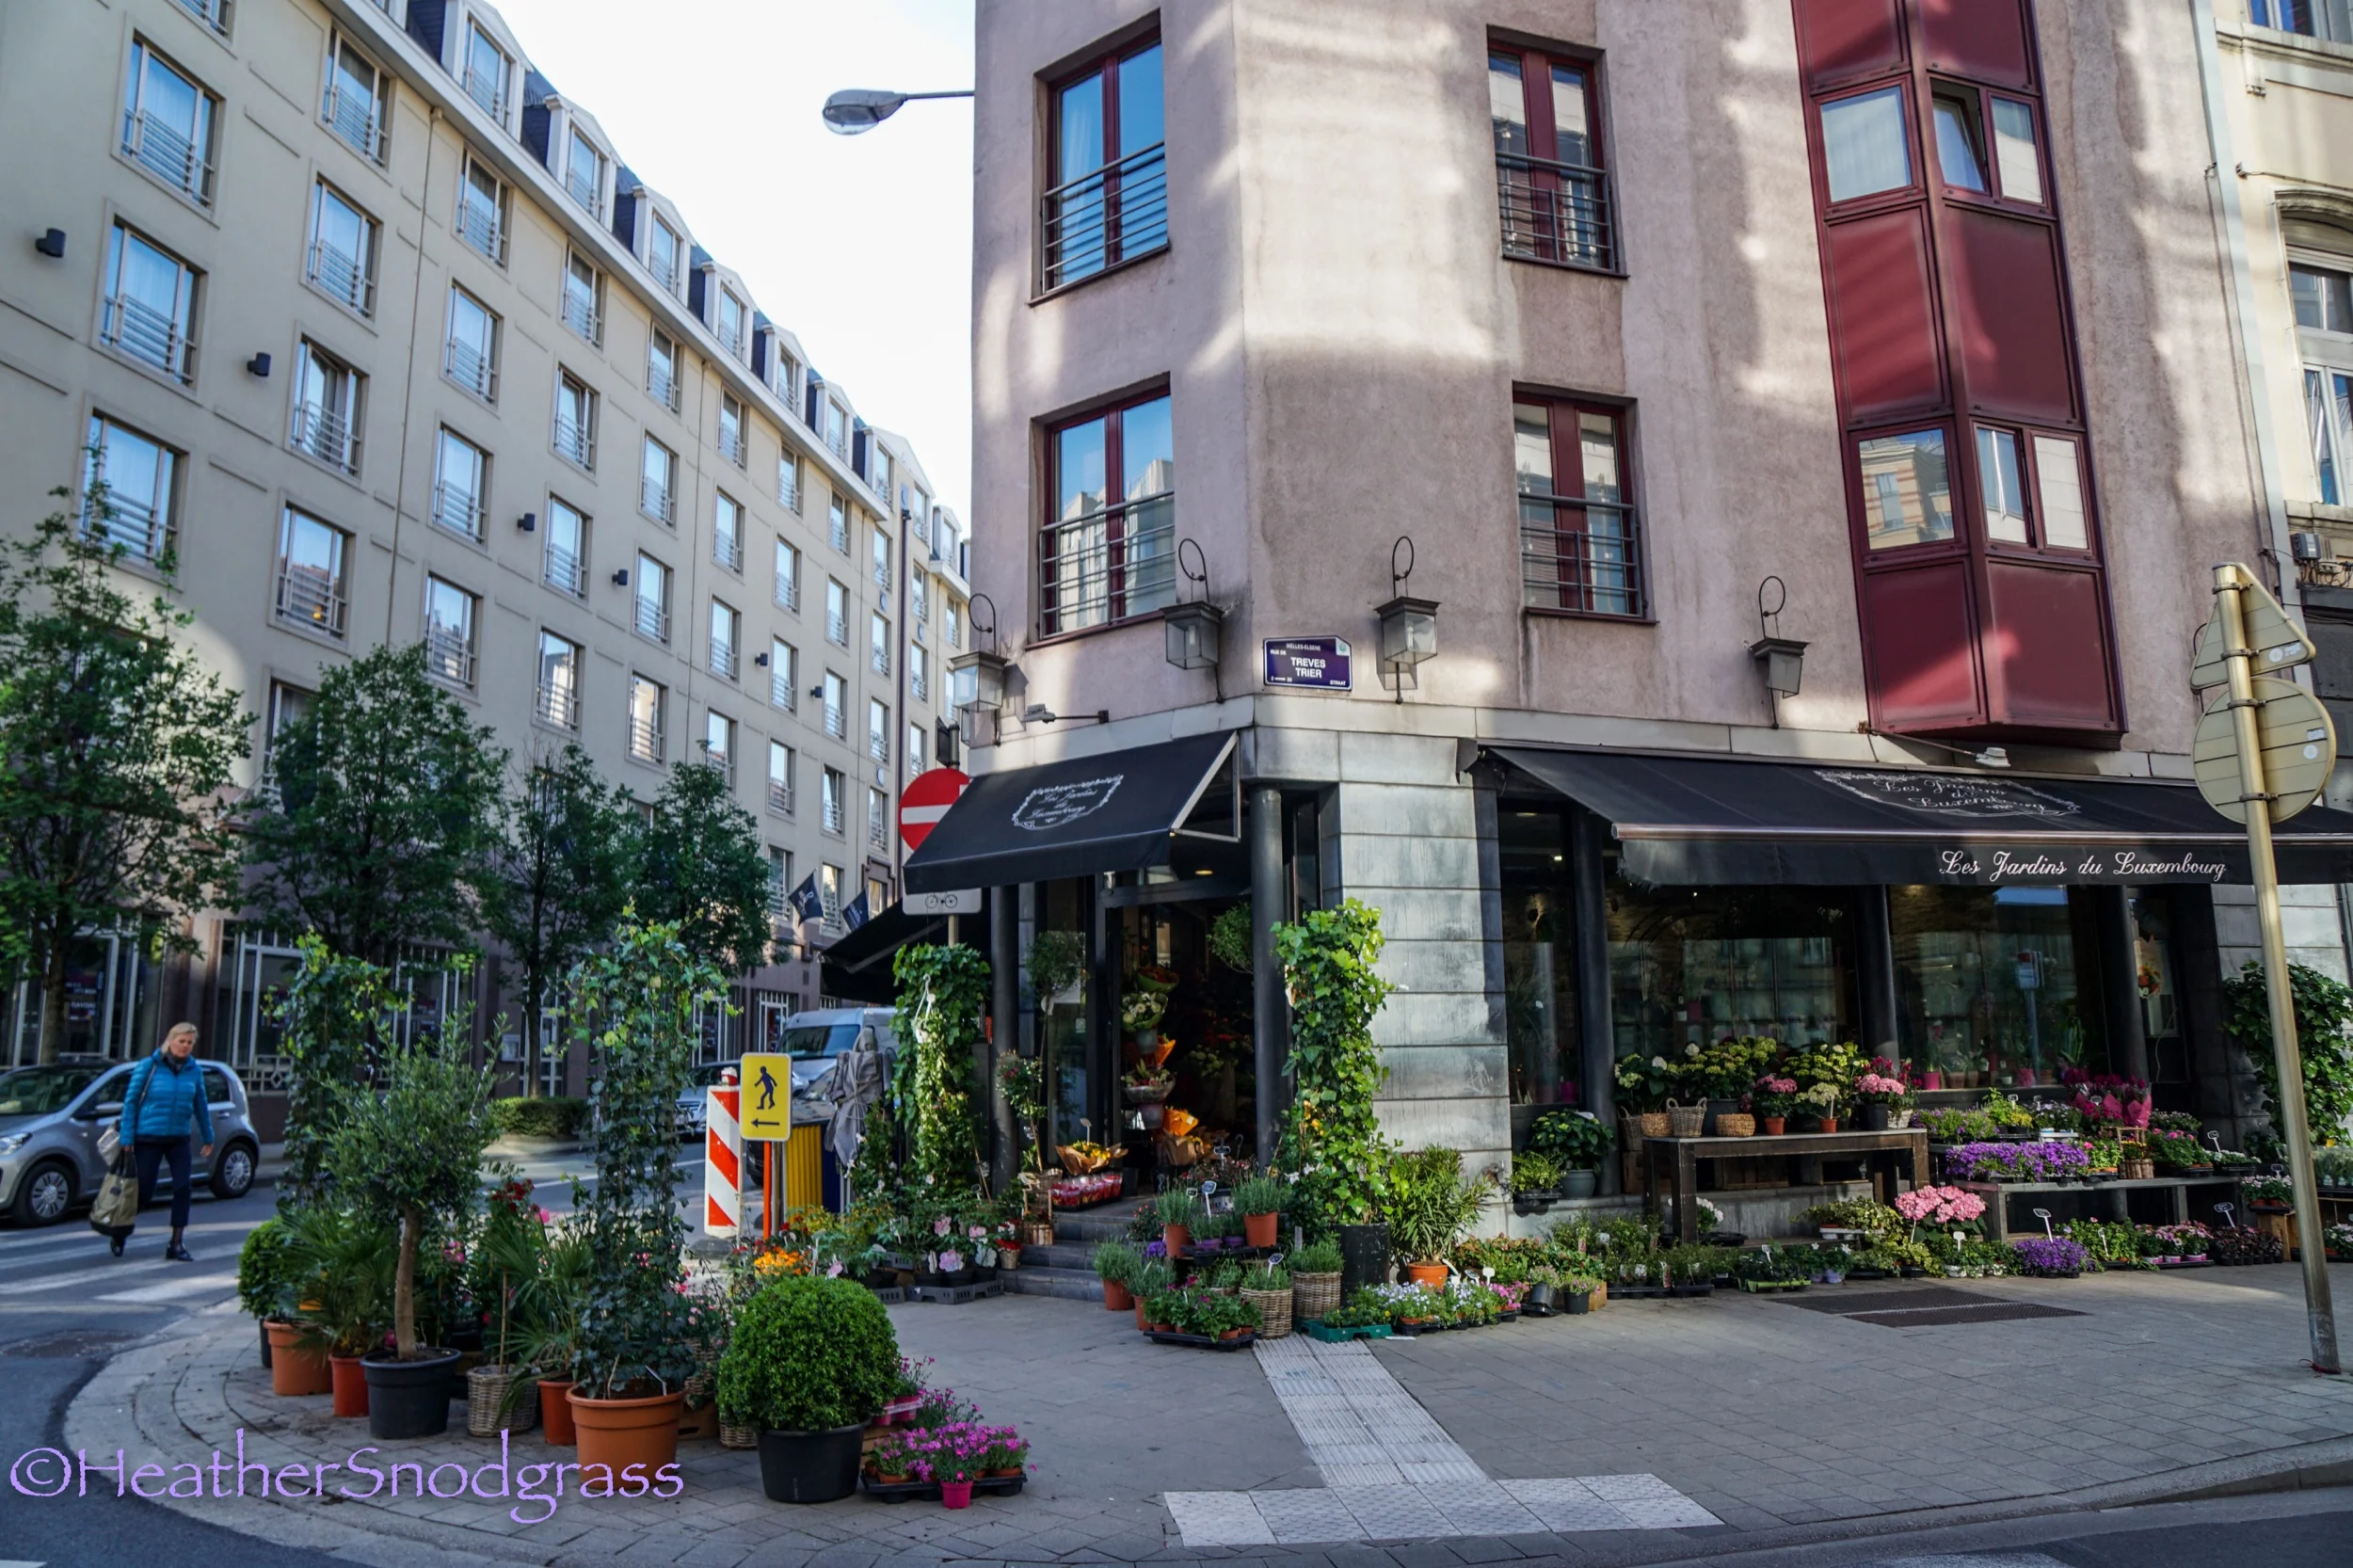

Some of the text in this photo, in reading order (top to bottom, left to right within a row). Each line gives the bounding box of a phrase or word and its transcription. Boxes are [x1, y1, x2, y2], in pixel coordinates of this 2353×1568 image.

[1286, 643, 1321, 651] IXELLES-ELSENE
[1290, 657, 1326, 669] TREVES
[1295, 667, 1322, 679] TRIER
[1939, 851, 2227, 882] Les Jardins du Luxembourg
